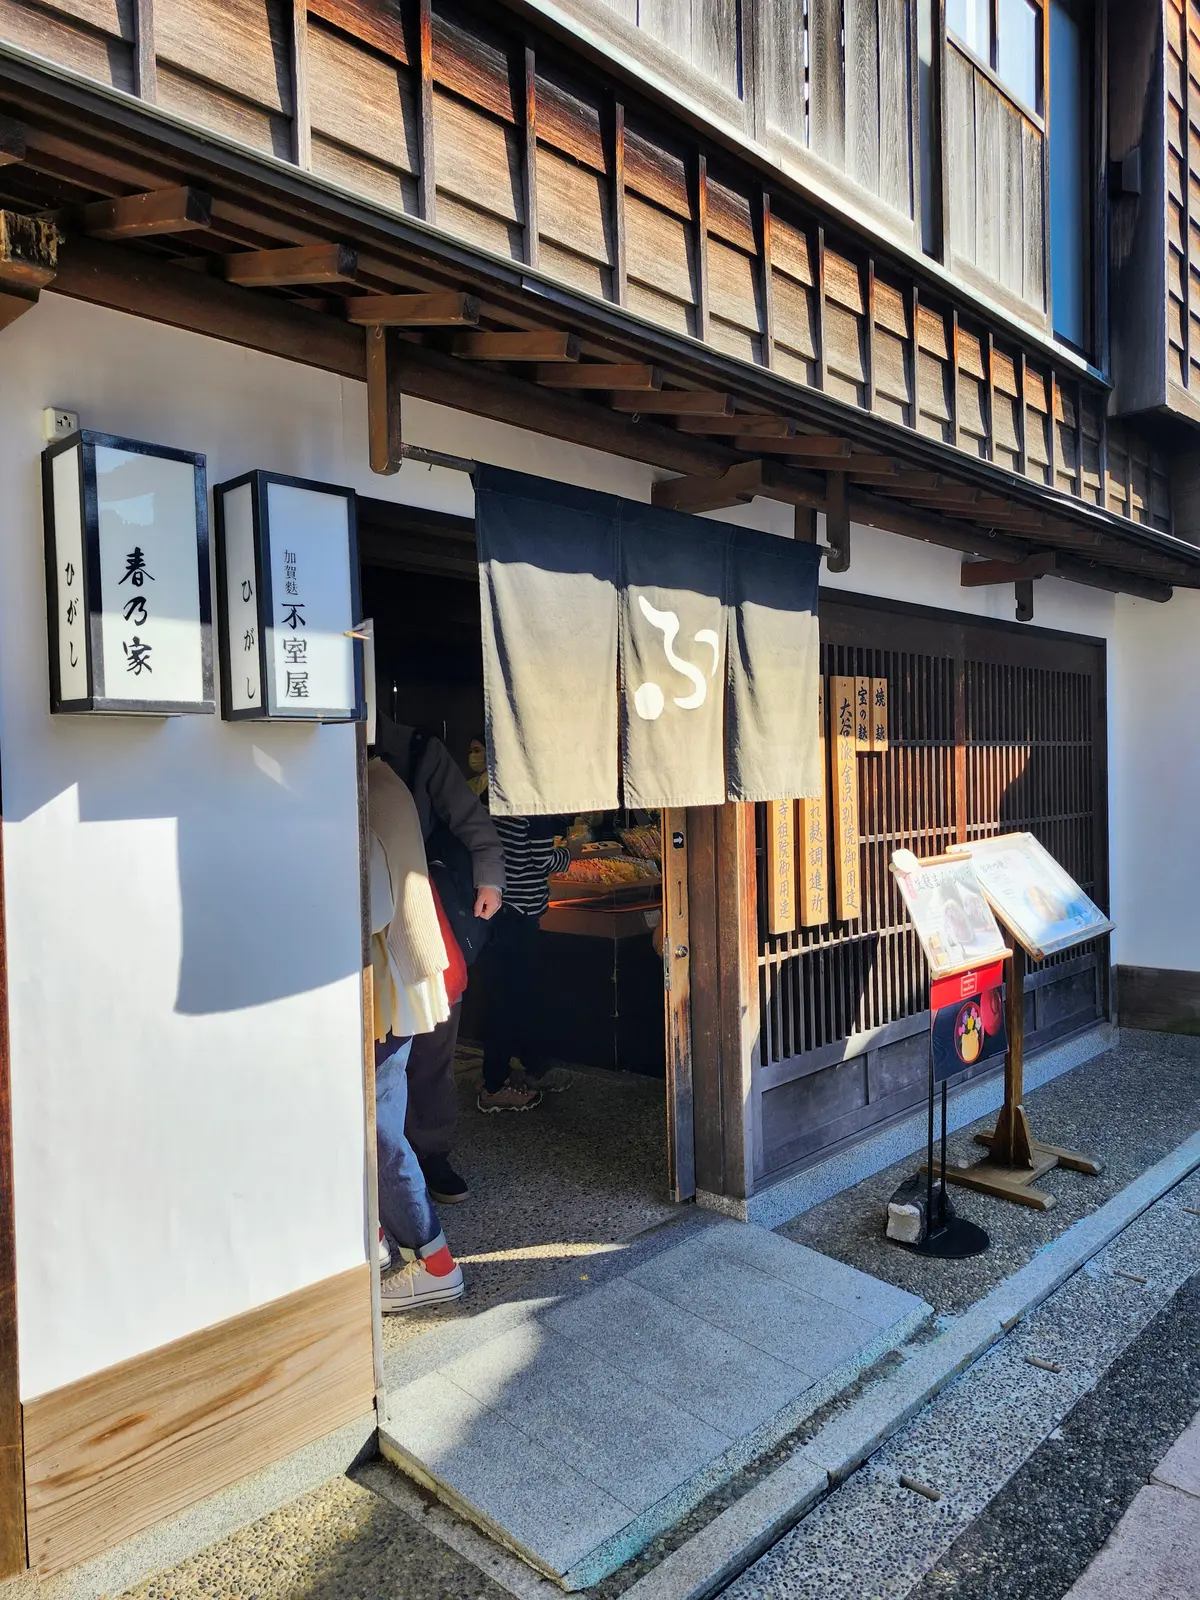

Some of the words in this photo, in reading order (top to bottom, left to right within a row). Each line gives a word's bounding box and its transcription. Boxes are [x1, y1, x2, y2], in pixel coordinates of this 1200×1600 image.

[65, 562, 79, 668] ひがし
[118, 547, 155, 677] 春乃家
[283, 549, 299, 596] 加賀麩
[241, 580, 256, 700] ひがし
[281, 603, 310, 699] 不室屋
